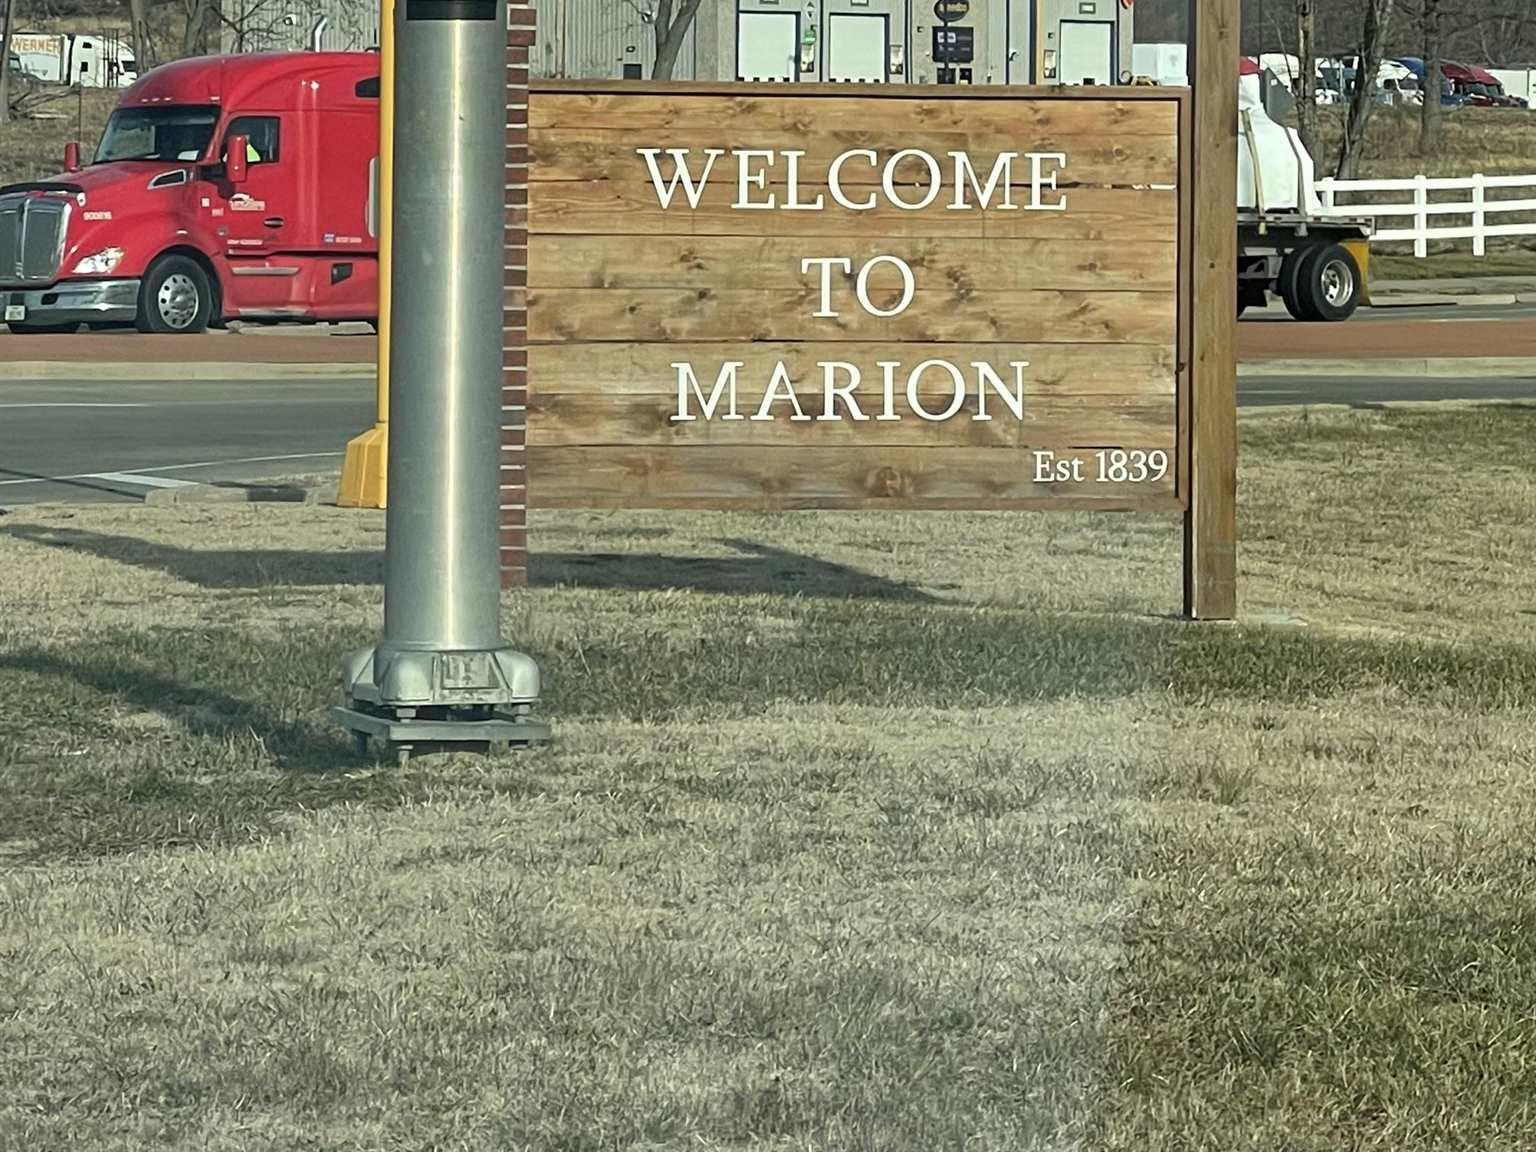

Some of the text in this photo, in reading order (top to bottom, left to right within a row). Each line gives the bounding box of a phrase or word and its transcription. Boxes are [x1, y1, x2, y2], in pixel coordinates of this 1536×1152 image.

[636, 148, 1068, 211] WELCOME
[801, 255, 916, 318] TO
[670, 359, 1030, 422] MARION
[1032, 449, 1168, 482] Est 1839
